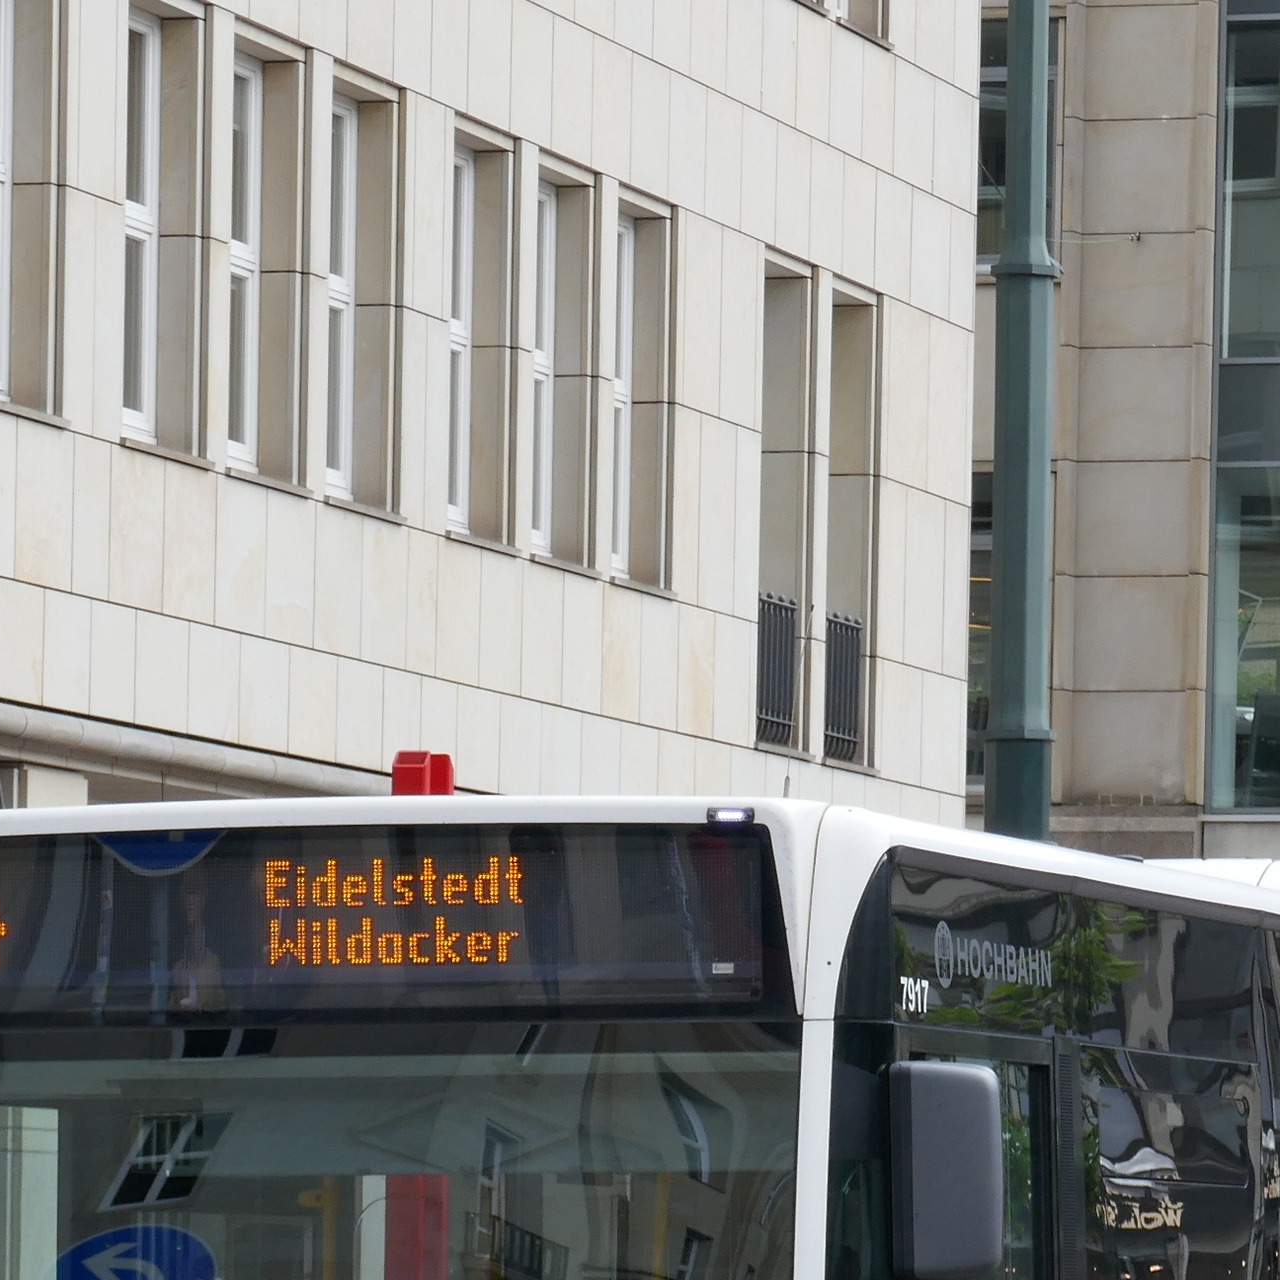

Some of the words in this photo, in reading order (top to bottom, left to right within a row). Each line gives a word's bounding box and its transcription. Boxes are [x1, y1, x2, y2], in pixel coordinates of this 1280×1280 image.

[265, 855, 525, 907] Eidelstedt
[270, 916, 518, 966] Wildacker
[957, 937, 1052, 988] HOCHBAHN
[900, 976, 929, 1013] 7917
